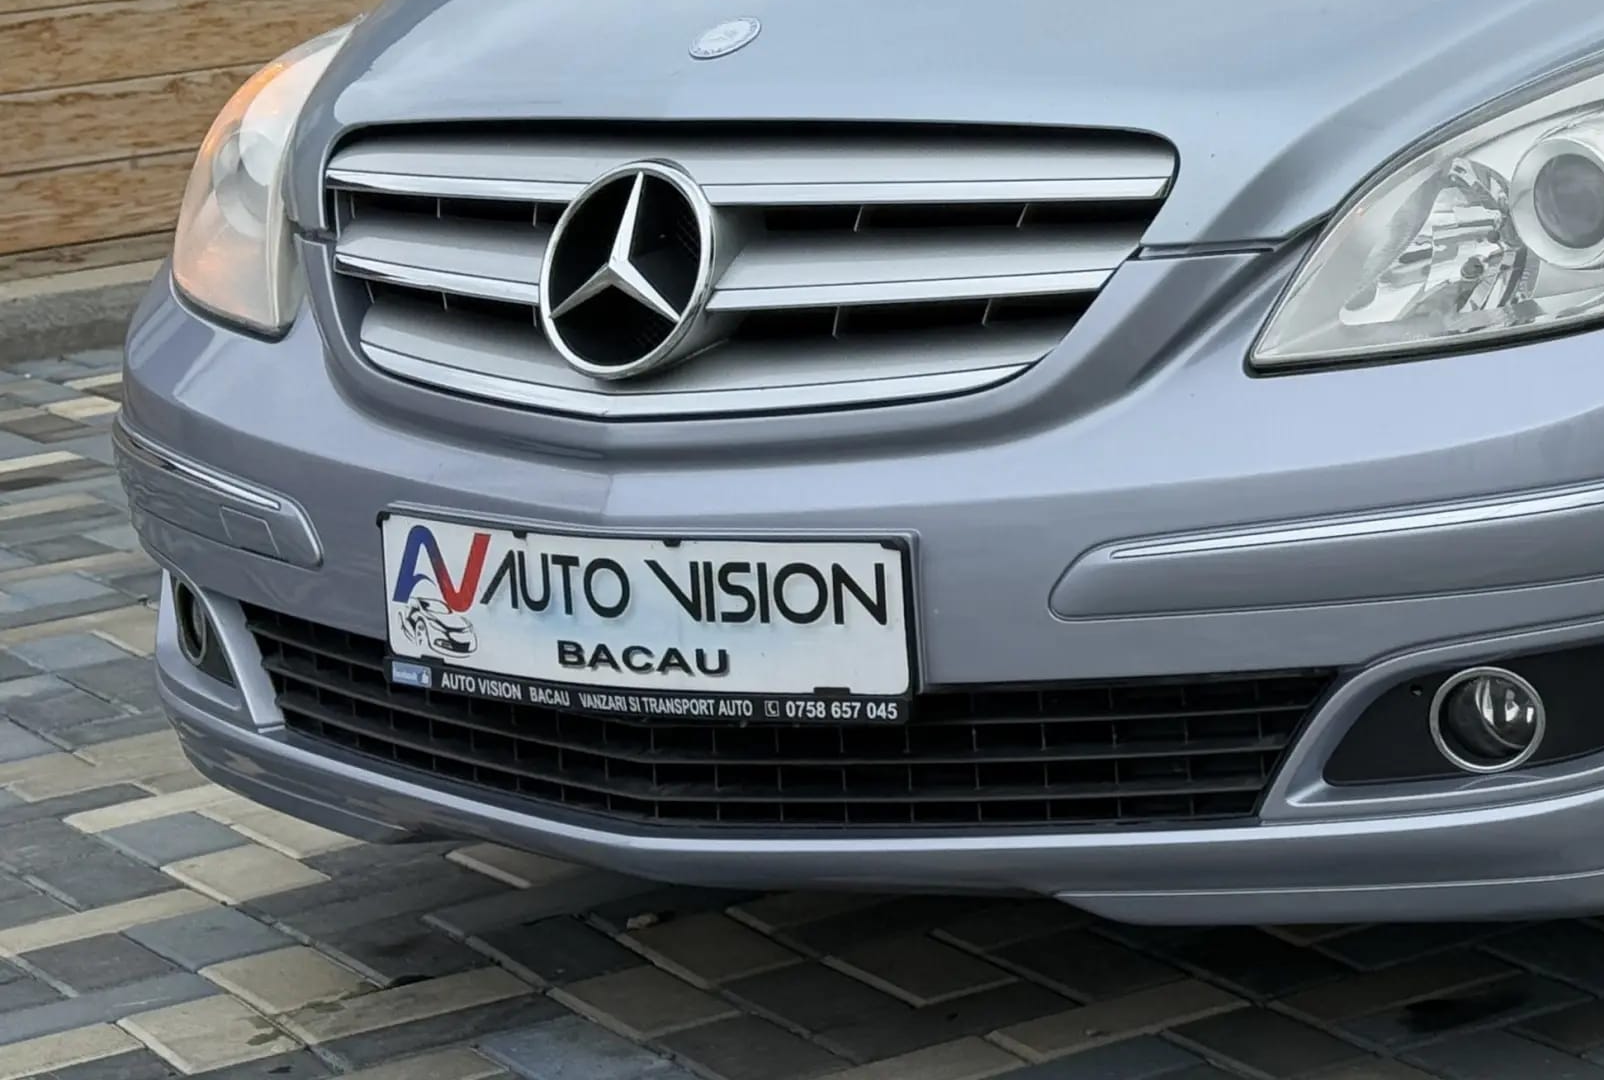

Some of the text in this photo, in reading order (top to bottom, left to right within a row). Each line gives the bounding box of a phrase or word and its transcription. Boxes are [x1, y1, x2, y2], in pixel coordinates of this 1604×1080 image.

[480, 550, 888, 626] AUTO VISION
[557, 639, 732, 677] BACAU
[441, 672, 475, 693] AUTO
[478, 679, 522, 701] VISION
[528, 686, 570, 707] BACAU
[578, 692, 627, 712] VANZARI
[629, 696, 641, 713] SI
[641, 697, 715, 716] TRANSPORT
[717, 699, 753, 717] AUTO
[785, 700, 826, 718] 0758
[831, 701, 861, 719] 657
[866, 702, 898, 720] 045
